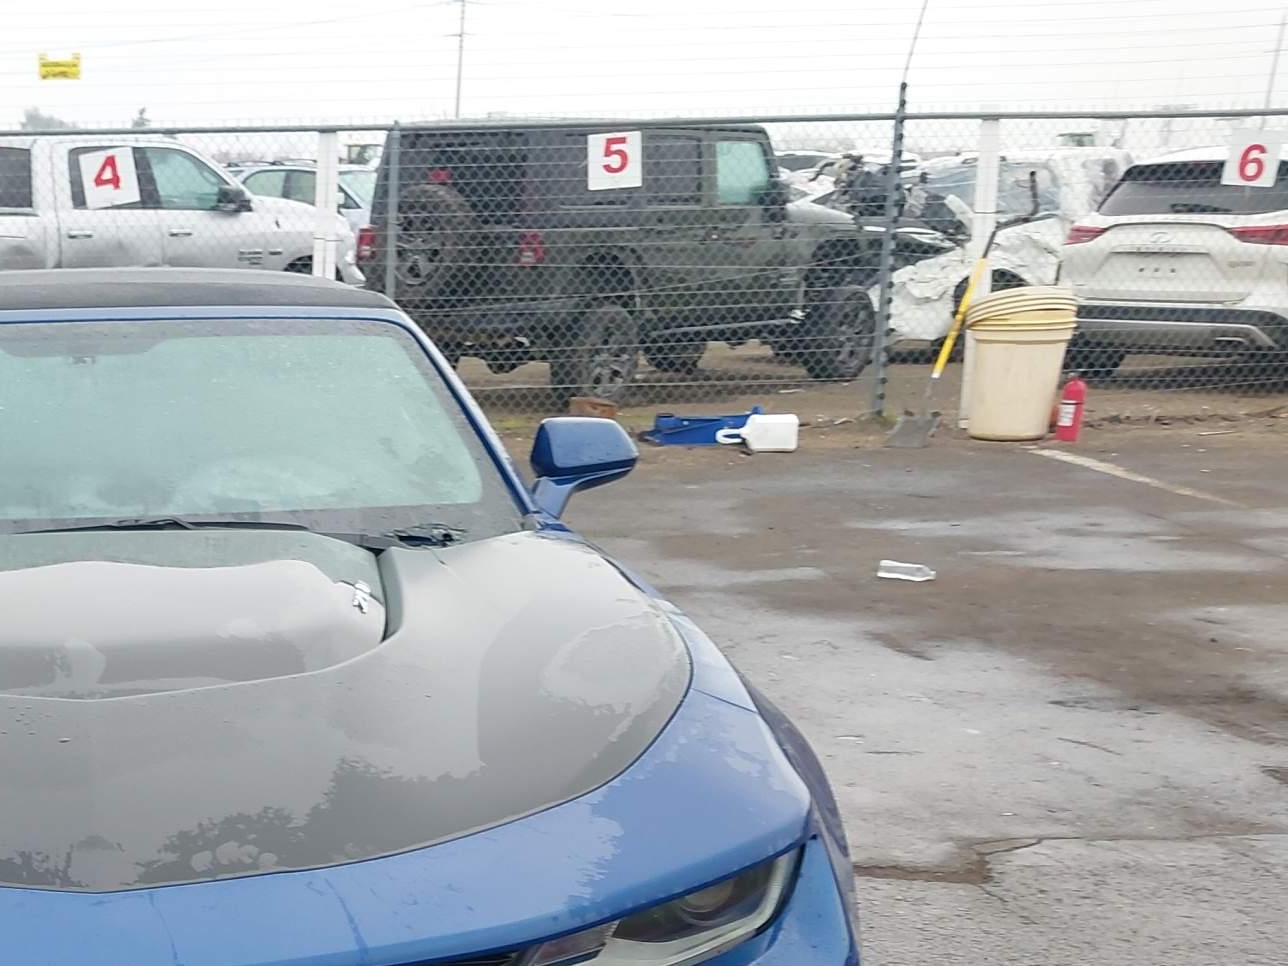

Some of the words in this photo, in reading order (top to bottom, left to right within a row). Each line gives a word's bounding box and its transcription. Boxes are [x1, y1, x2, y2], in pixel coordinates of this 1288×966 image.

[94, 154, 120, 190] 4
[602, 137, 628, 173] 5
[1239, 143, 1267, 182] 6
